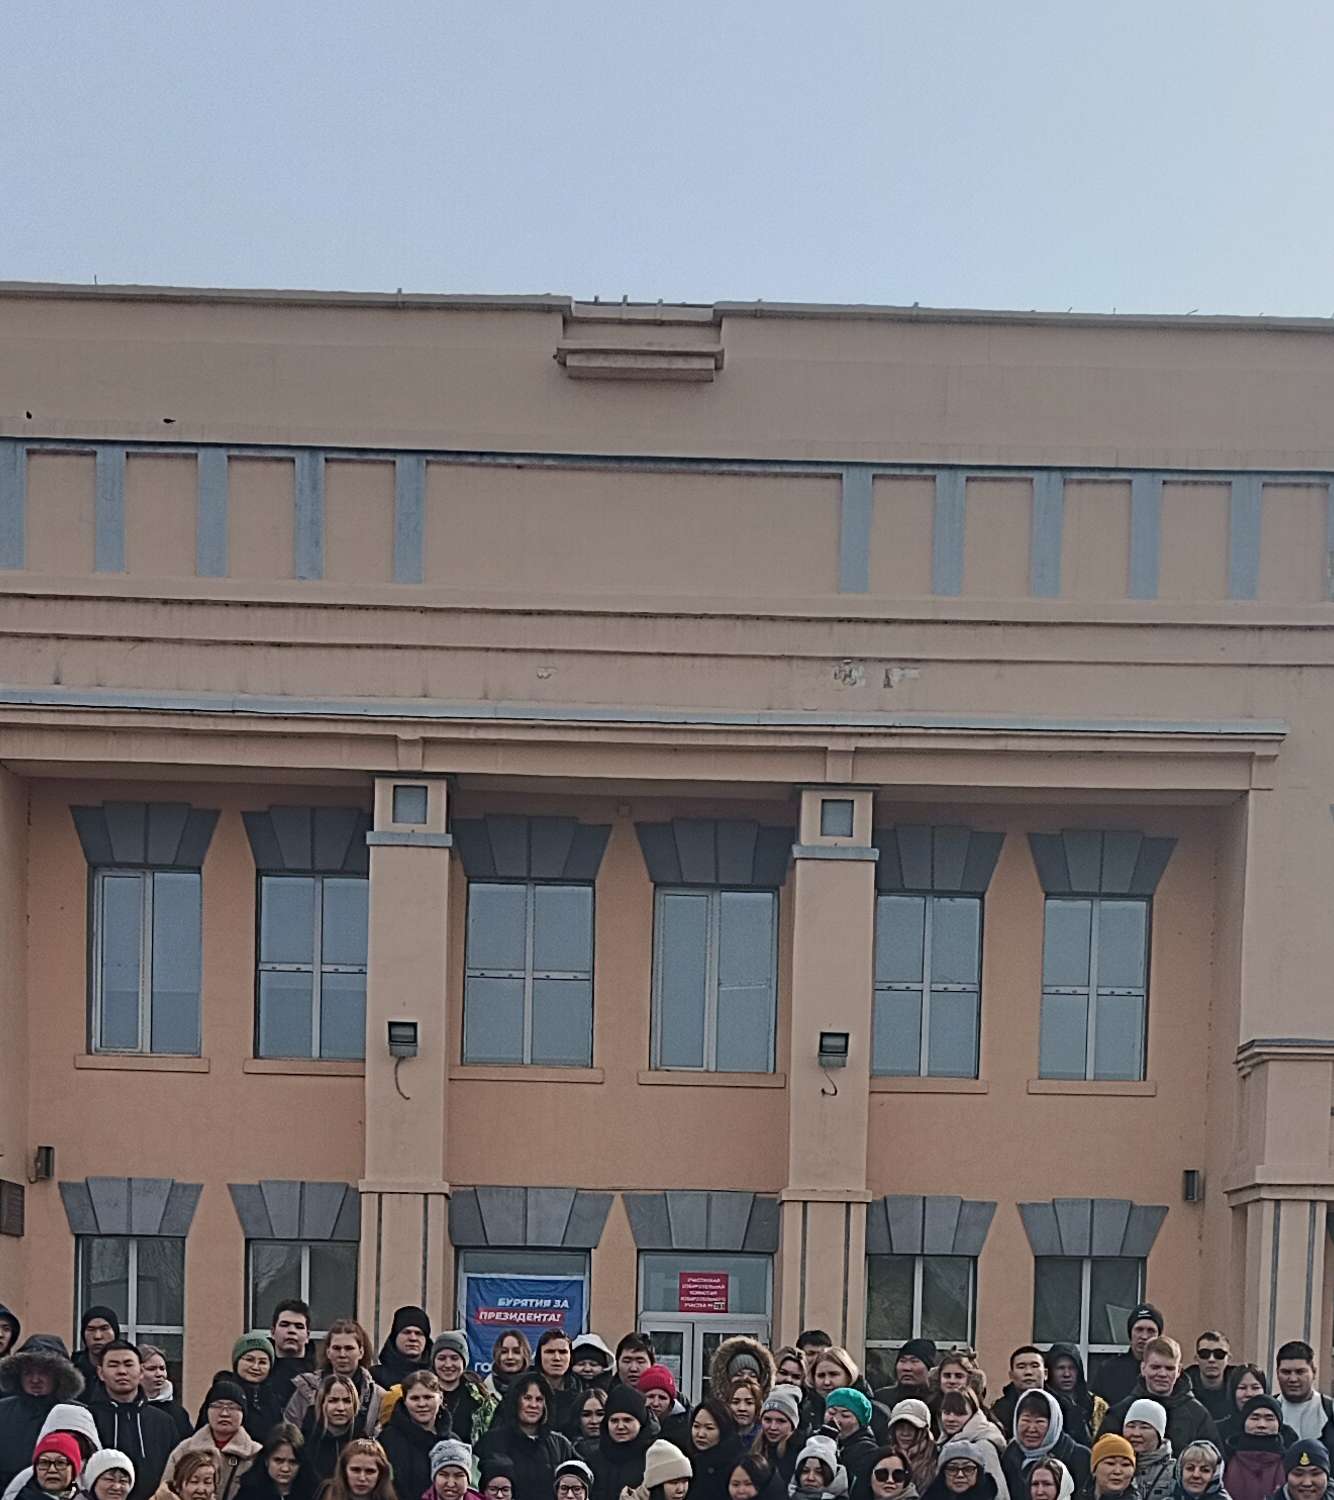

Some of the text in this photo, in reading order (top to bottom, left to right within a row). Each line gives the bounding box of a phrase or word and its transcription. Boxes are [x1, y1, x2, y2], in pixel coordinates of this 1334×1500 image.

[497, 1297, 570, 1309] БУРЯТИЯ ЗА
[479, 1311, 562, 1323] ПРЕЗИДЕНТА!
